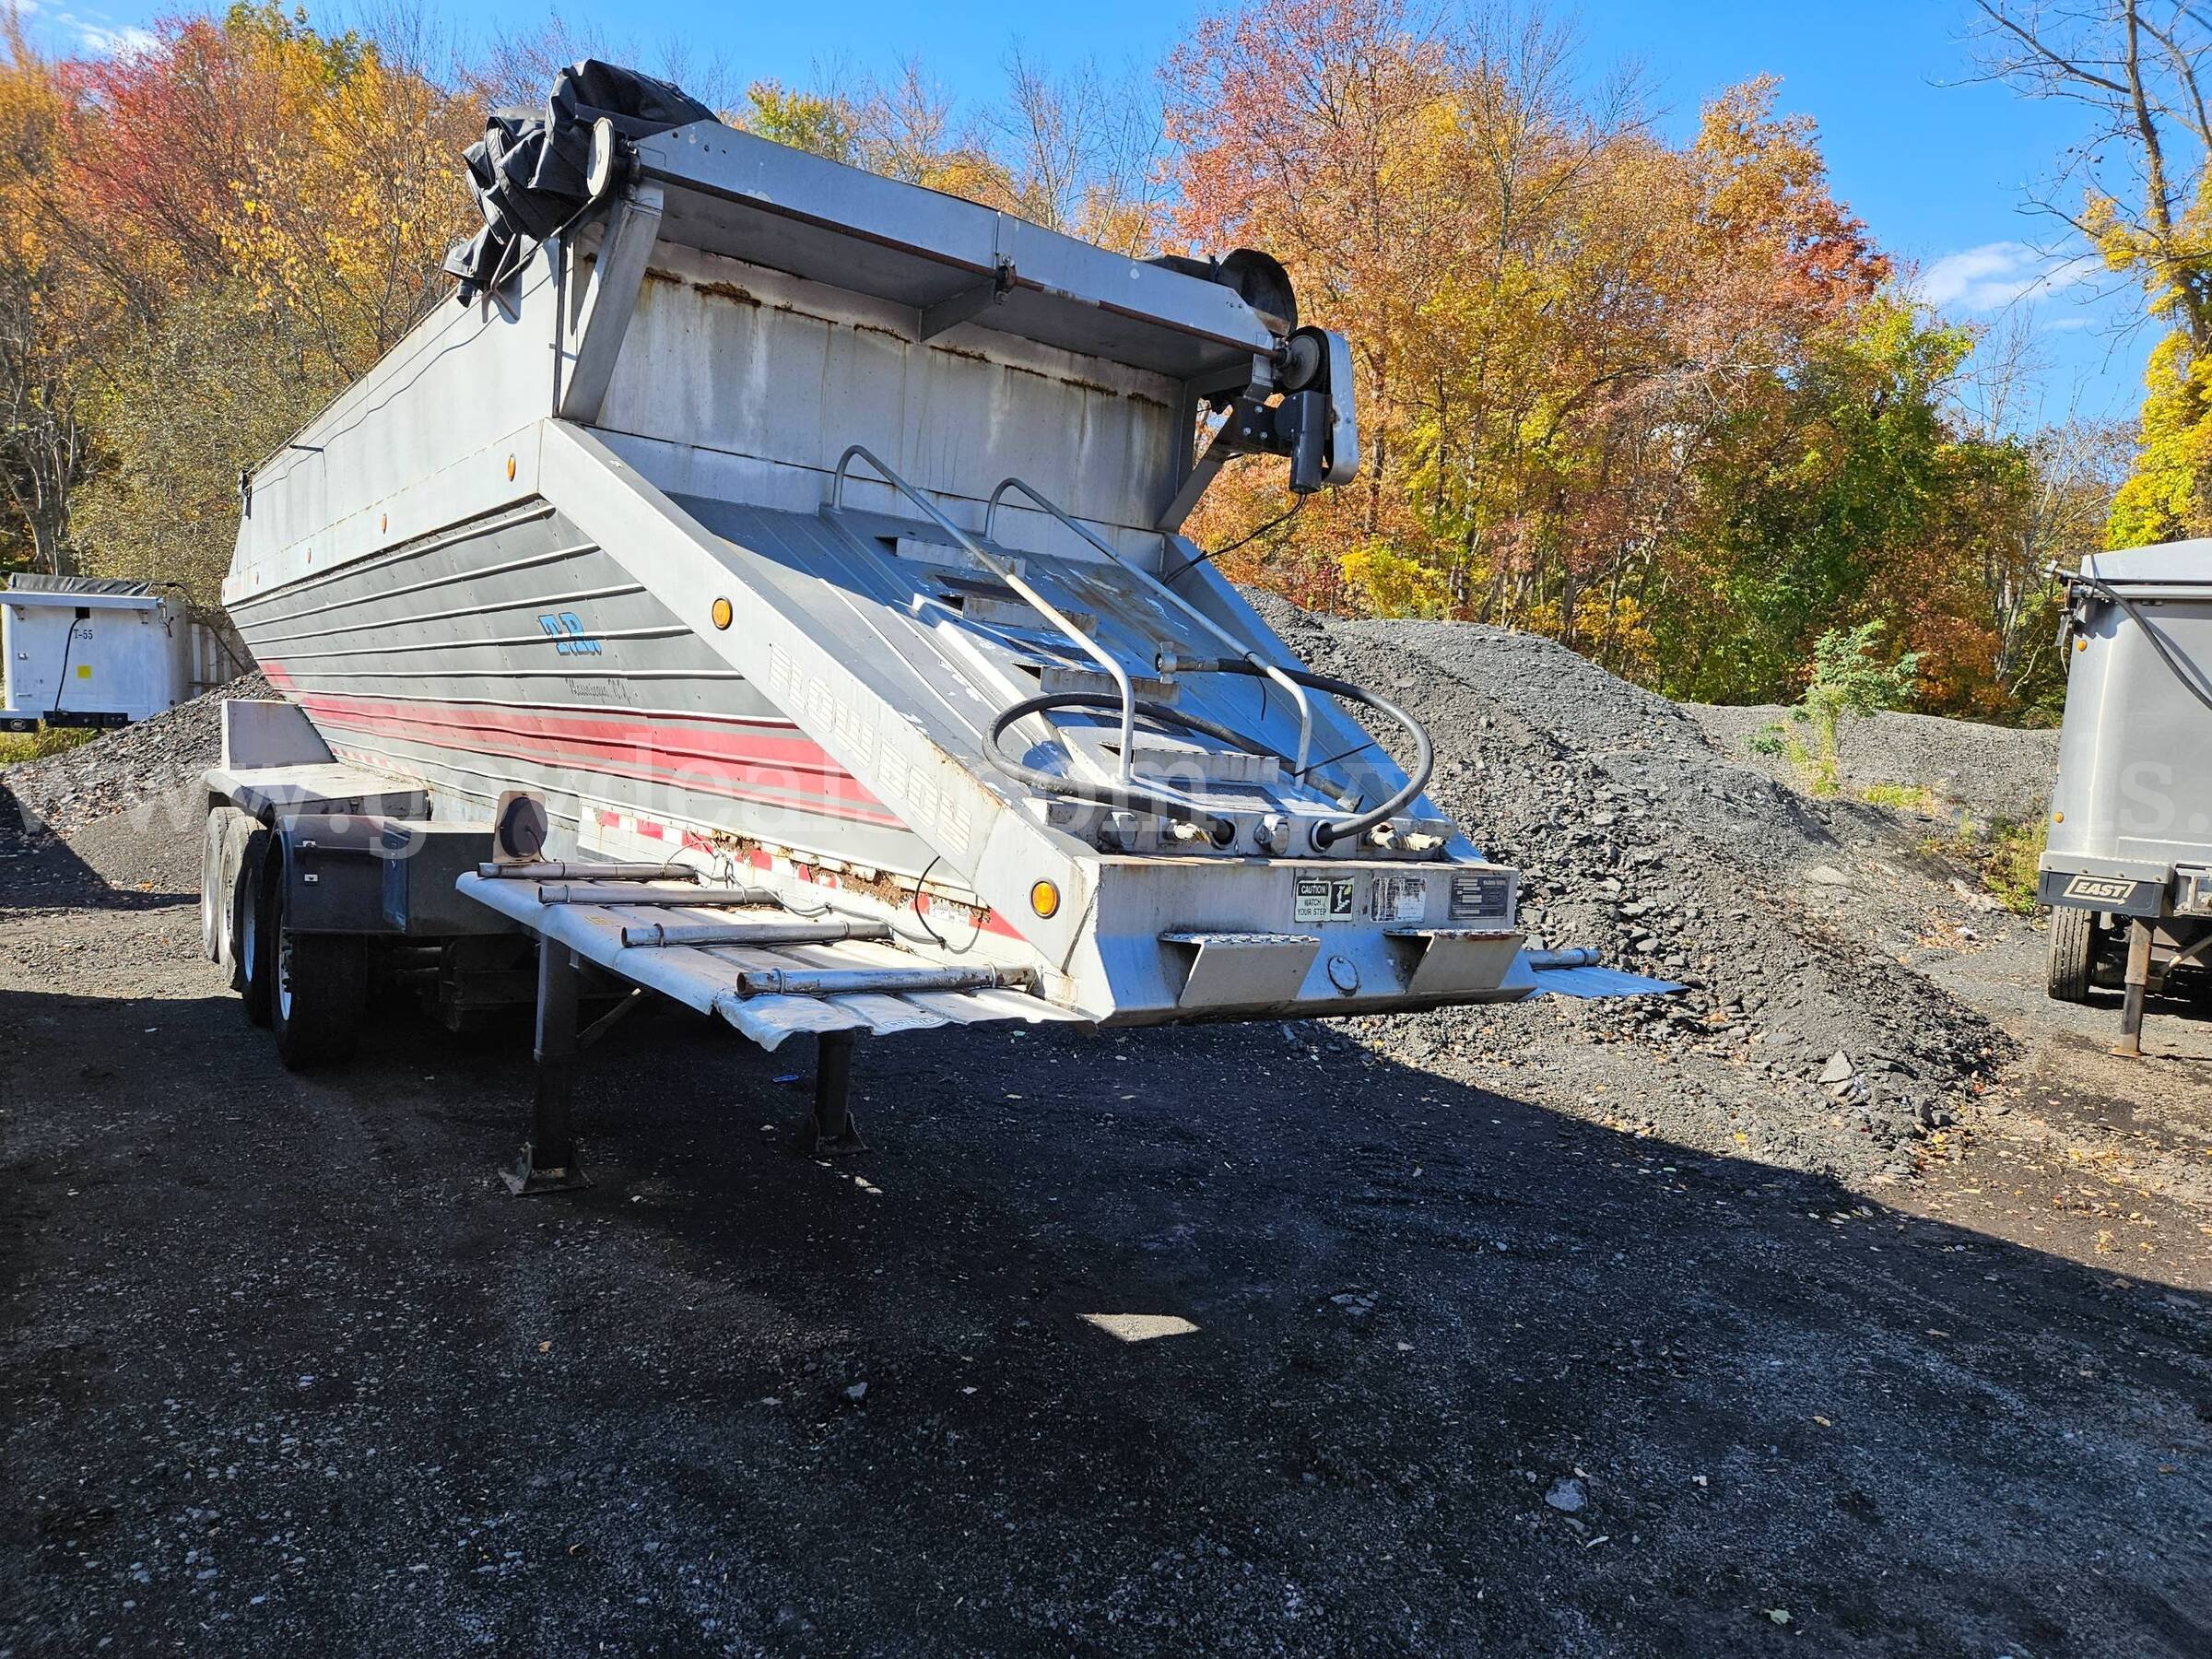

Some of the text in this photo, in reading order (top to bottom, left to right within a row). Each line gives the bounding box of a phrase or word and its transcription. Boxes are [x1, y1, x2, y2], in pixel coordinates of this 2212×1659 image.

[74, 629, 93, 640] T-55
[1300, 885, 1325, 894] CAUTION
[2074, 881, 2127, 898] EAST
